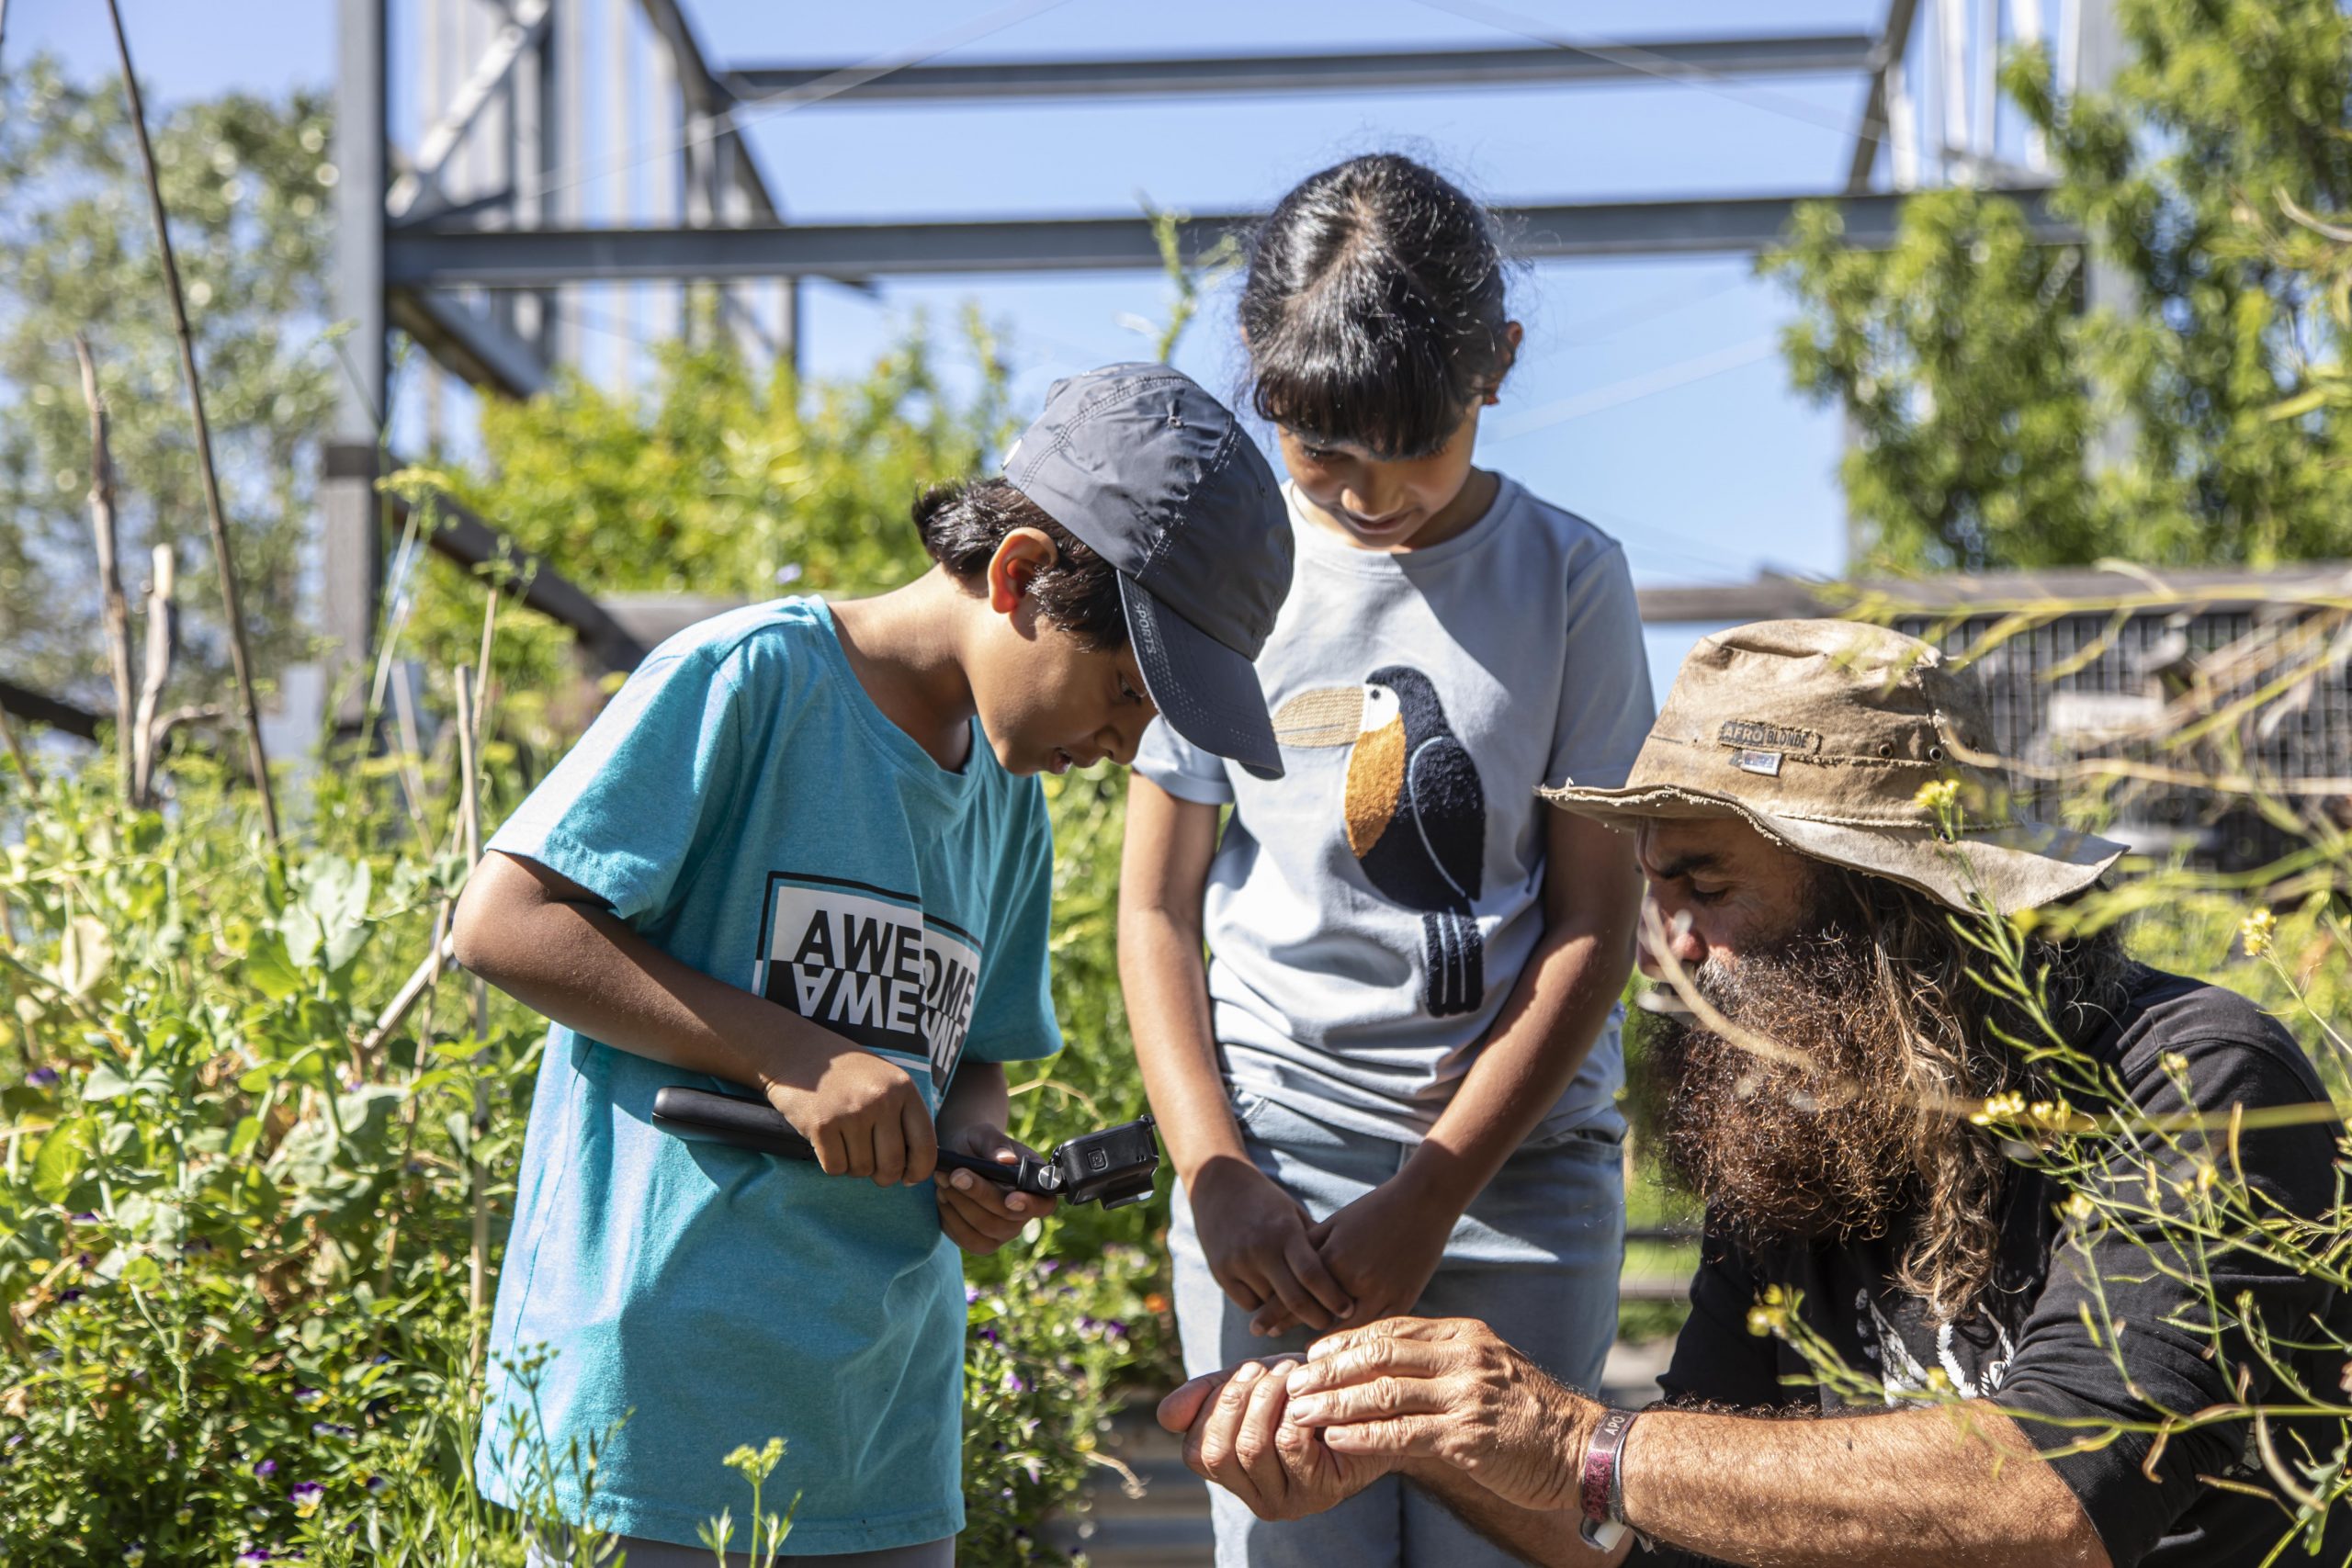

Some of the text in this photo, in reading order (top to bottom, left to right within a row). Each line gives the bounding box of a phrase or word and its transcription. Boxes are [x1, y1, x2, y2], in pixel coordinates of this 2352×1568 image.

[1134, 602, 1157, 654] SPORTS
[1724, 726, 1807, 748] AFRO BLONDE
[793, 909, 975, 1030] AWEOME
